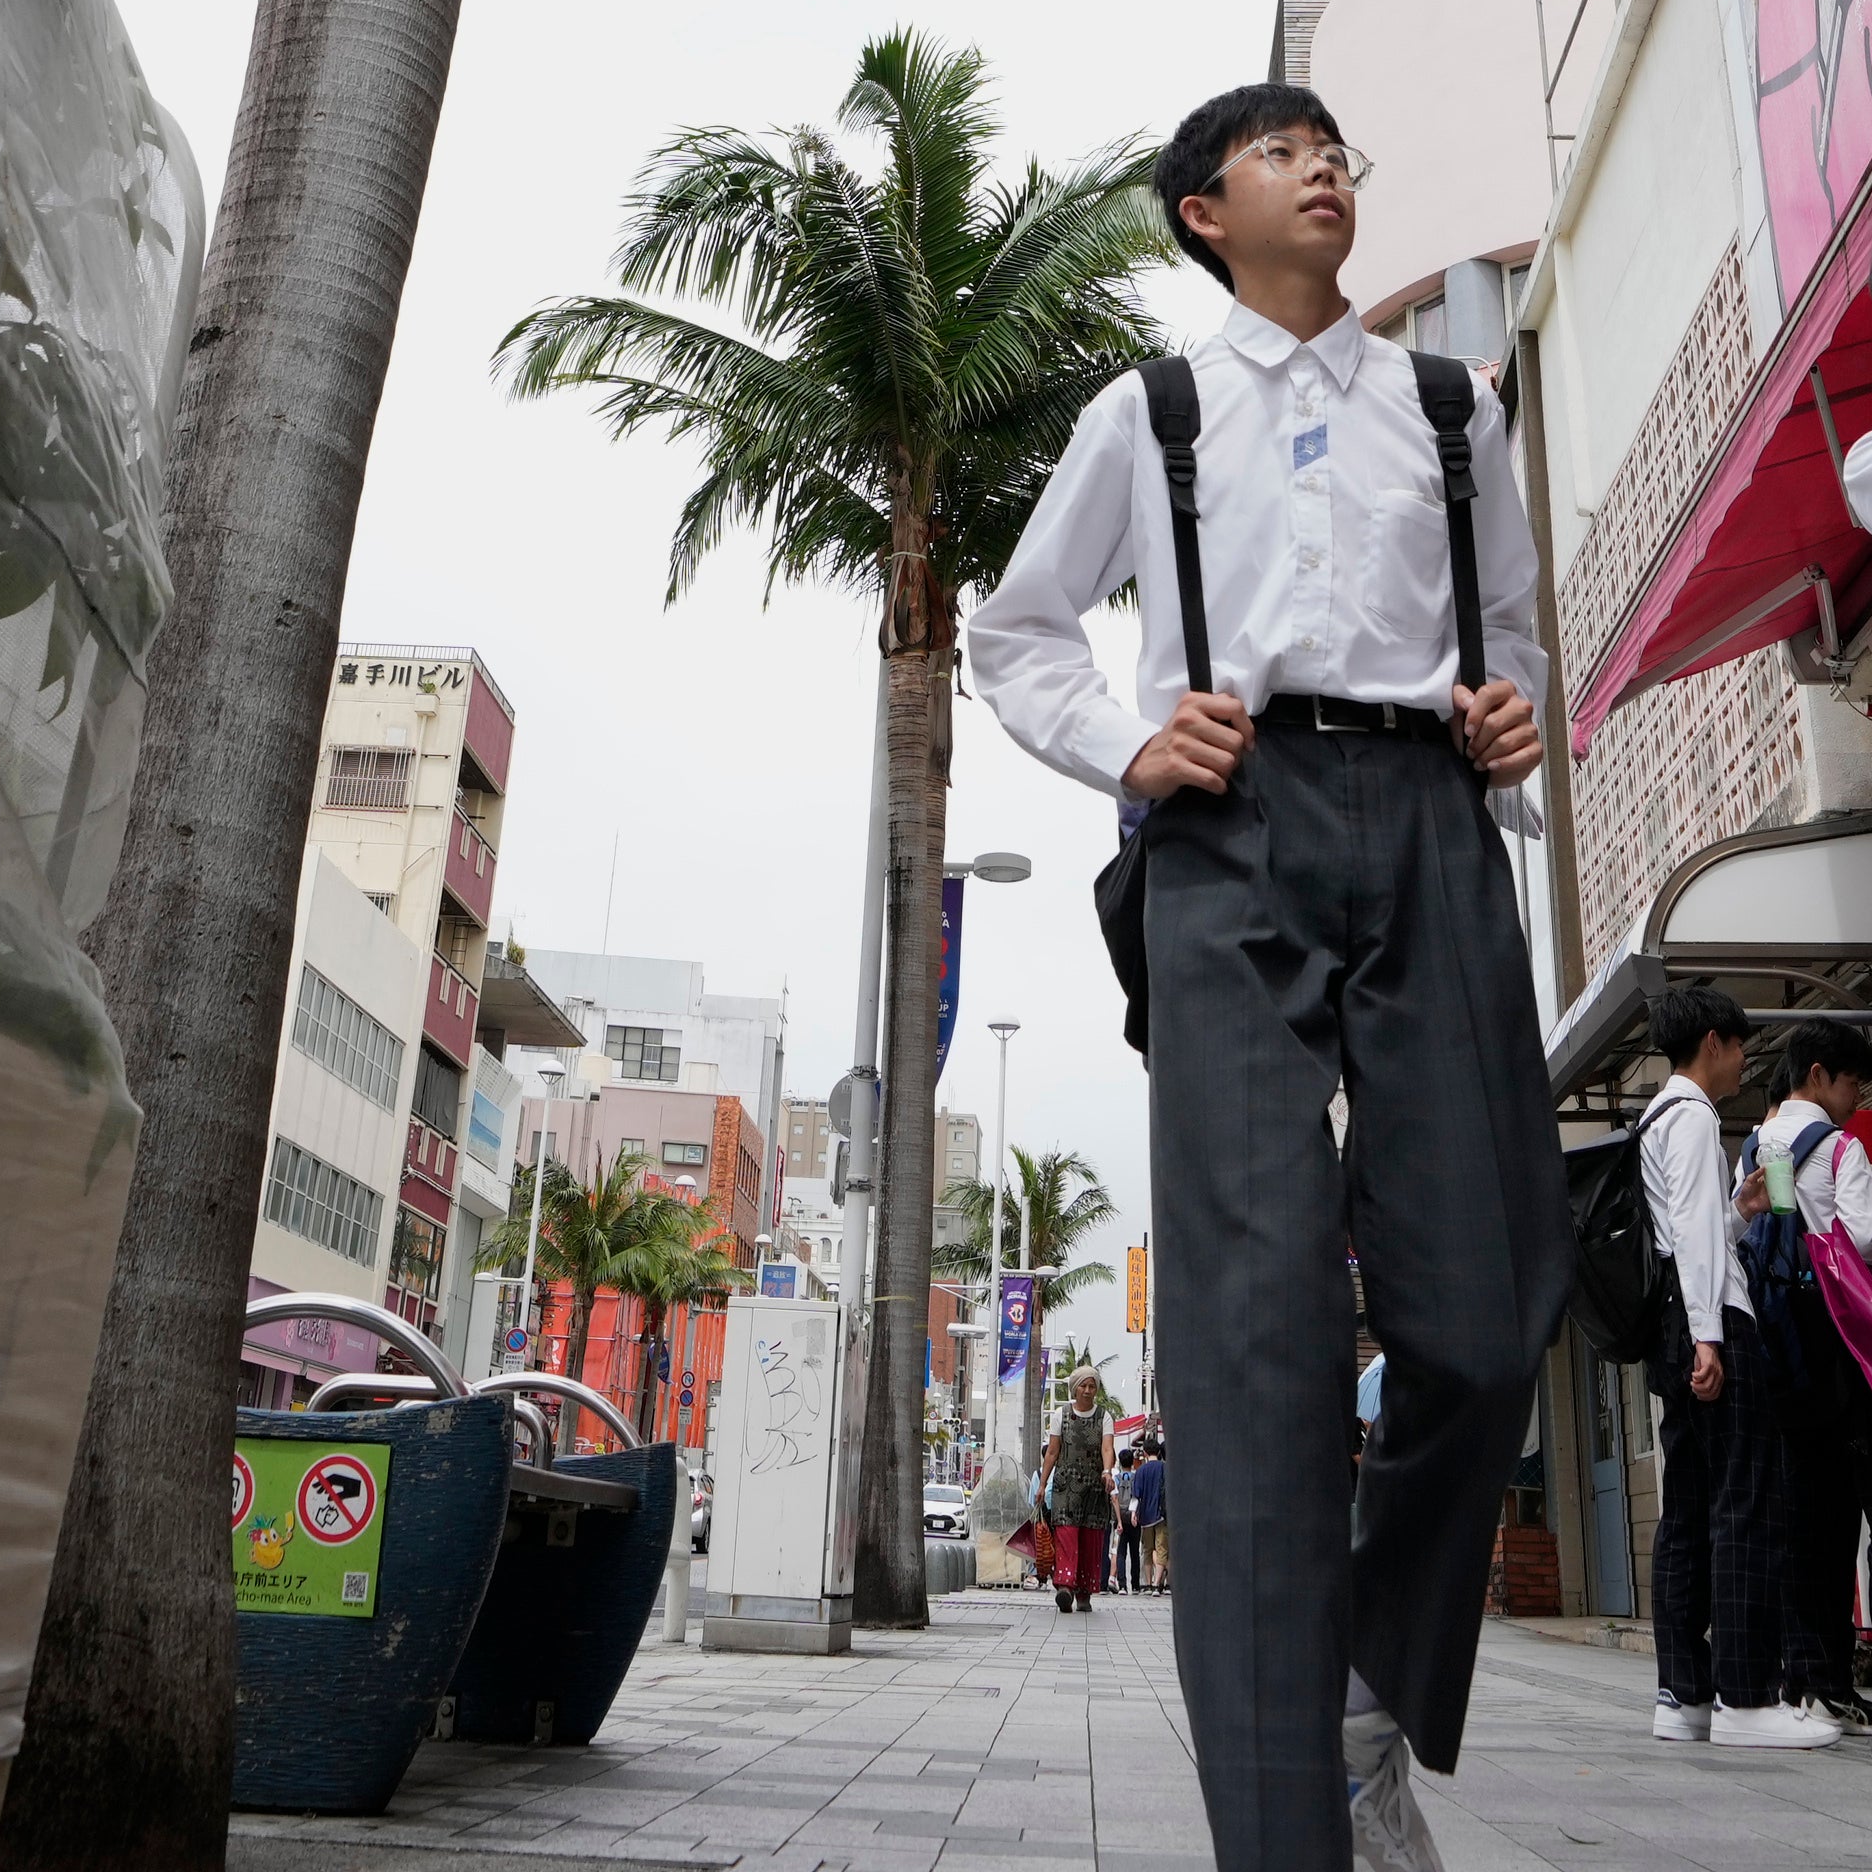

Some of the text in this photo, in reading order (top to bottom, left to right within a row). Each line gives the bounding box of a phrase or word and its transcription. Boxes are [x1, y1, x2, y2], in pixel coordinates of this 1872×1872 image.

[339, 663, 466, 689] 嘉手川ビル
[233, 1590, 312, 1606] cho-mae Area
